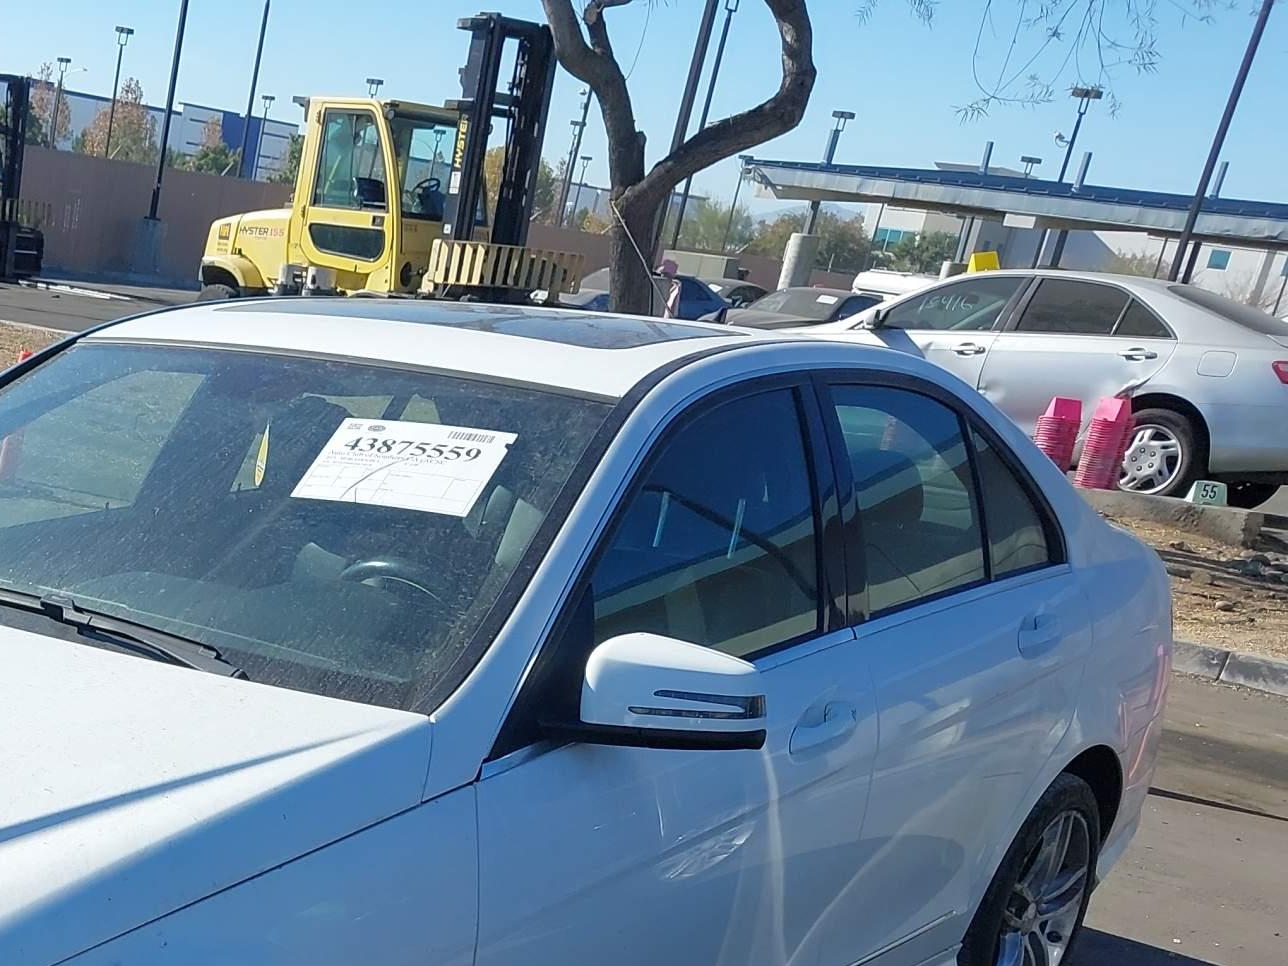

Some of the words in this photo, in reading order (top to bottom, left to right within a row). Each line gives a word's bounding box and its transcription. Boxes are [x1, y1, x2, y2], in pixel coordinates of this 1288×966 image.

[453, 113, 469, 169] HYSTER
[239, 226, 269, 237] HYSTER
[344, 436, 482, 463] 43875559
[1200, 484, 1218, 499] 55
